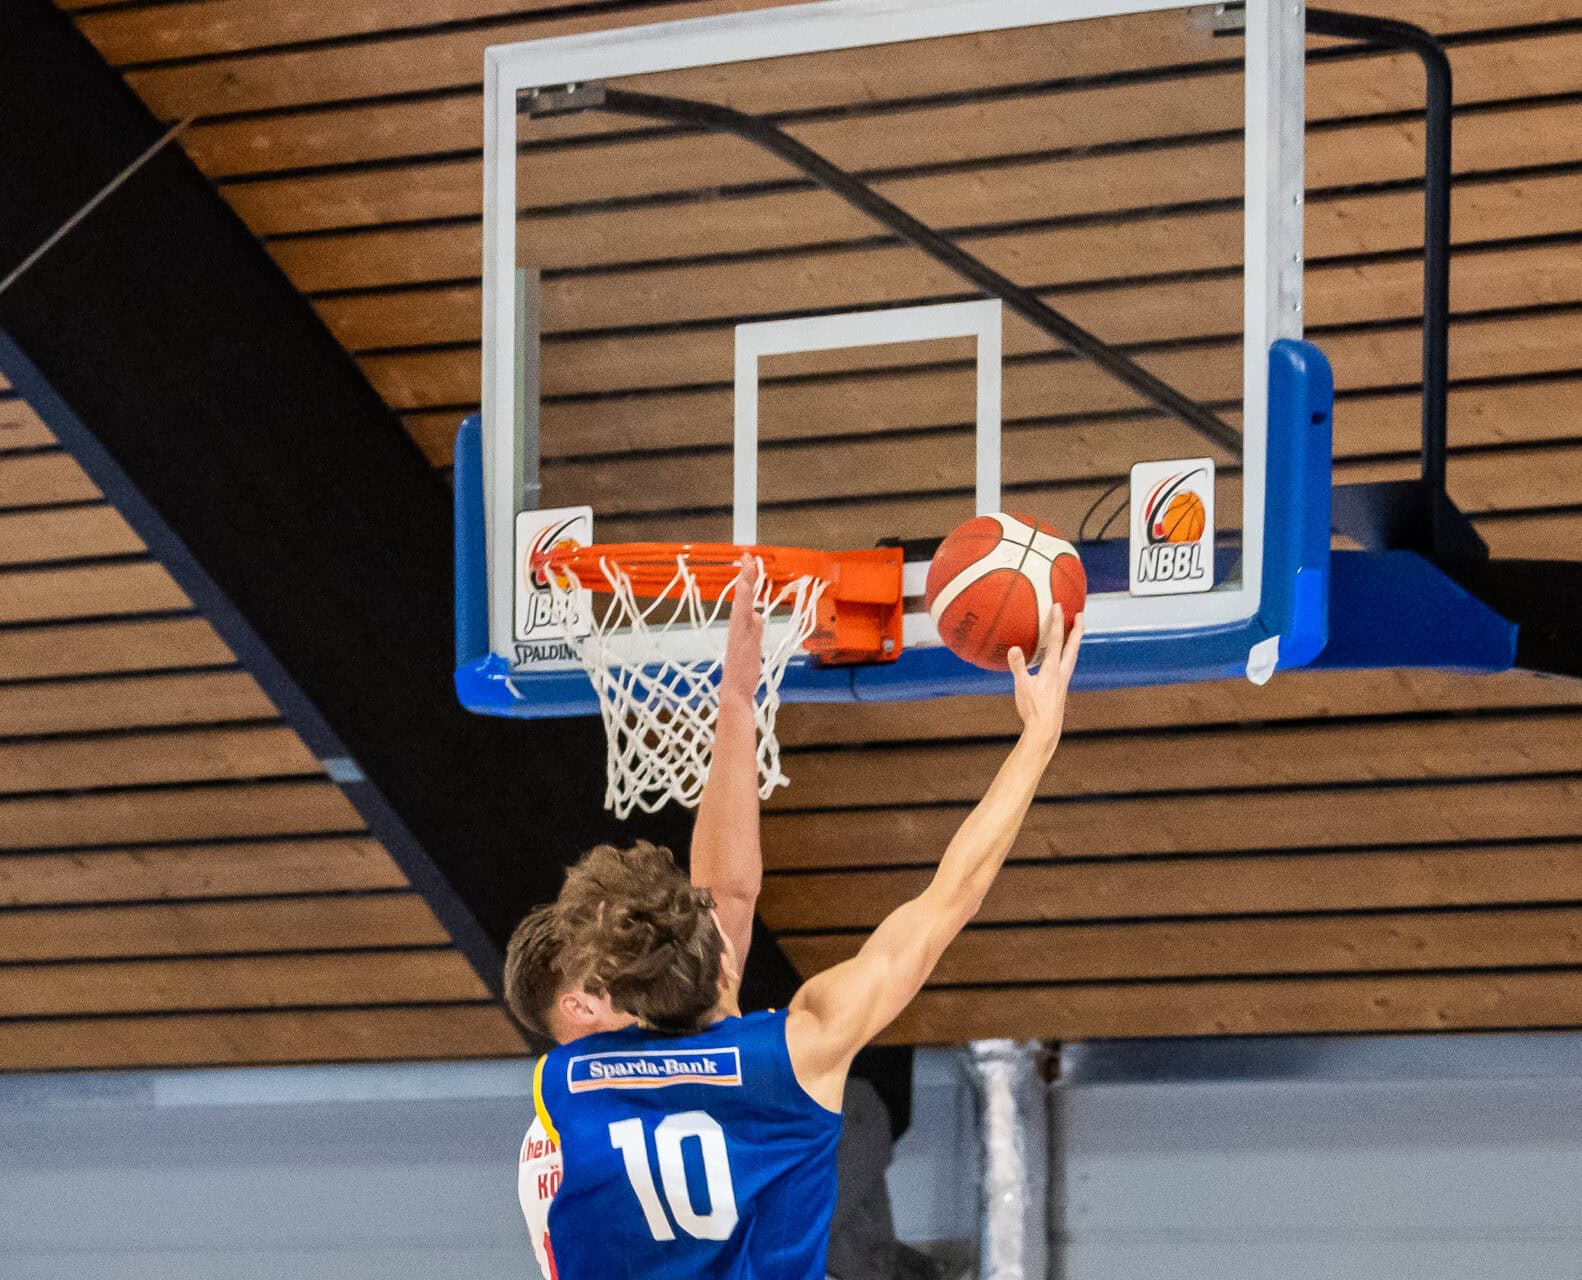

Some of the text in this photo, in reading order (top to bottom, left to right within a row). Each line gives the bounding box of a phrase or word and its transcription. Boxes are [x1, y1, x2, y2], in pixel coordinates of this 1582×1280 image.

[1138, 543, 1204, 582] NBBL
[589, 1057, 718, 1079] Sparda-Bank
[608, 1110, 739, 1241] 10
